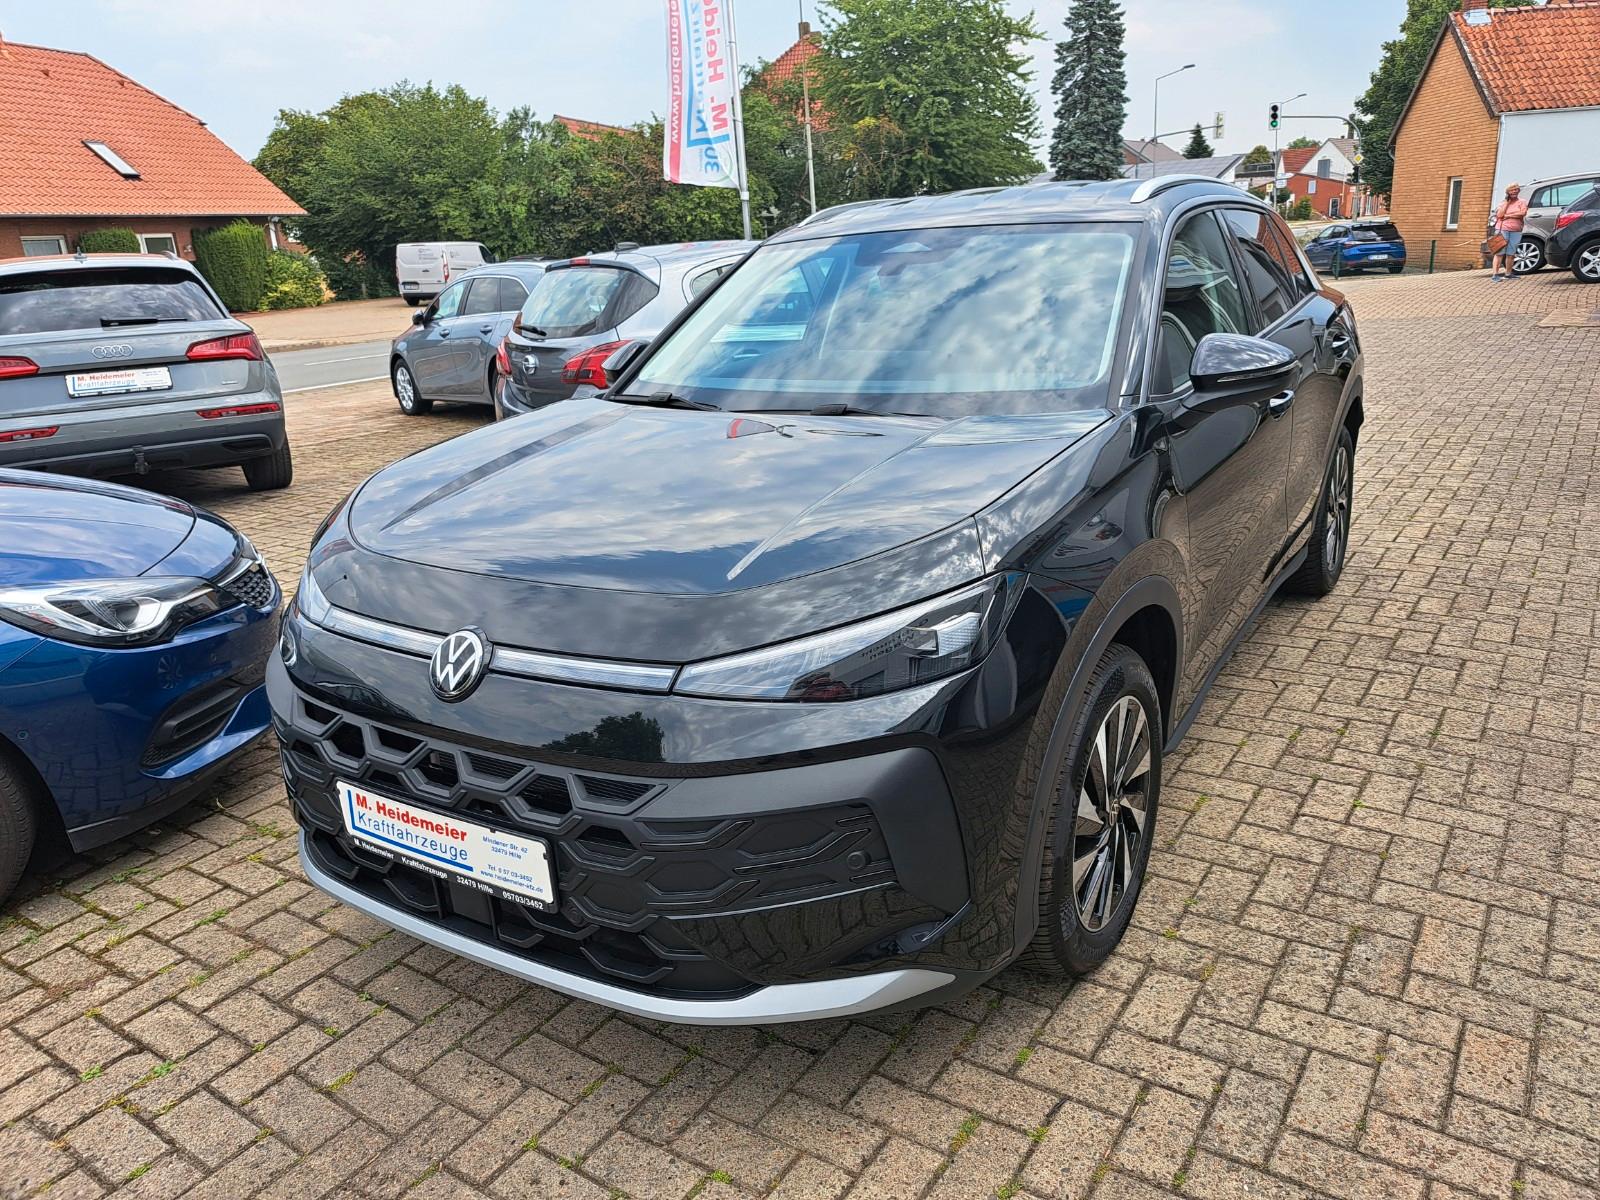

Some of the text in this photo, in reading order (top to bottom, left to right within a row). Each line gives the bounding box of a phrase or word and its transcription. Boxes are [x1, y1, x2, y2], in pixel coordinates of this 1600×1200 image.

[431, 632, 482, 694] VW
[356, 793, 467, 842] M. Heidemeier
[357, 811, 468, 861] Kraftfahrzeuge
[482, 835, 508, 848] Mindener
[509, 843, 519, 851] Str.
[491, 846, 522, 860] 32479 Hille
[361, 841, 395, 860] Heidemeier
[401, 856, 448, 879] Kraftfahrzeuge
[456, 875, 477, 889] 32479
[477, 882, 494, 894] Hille
[502, 890, 544, 910] 05703/3452
